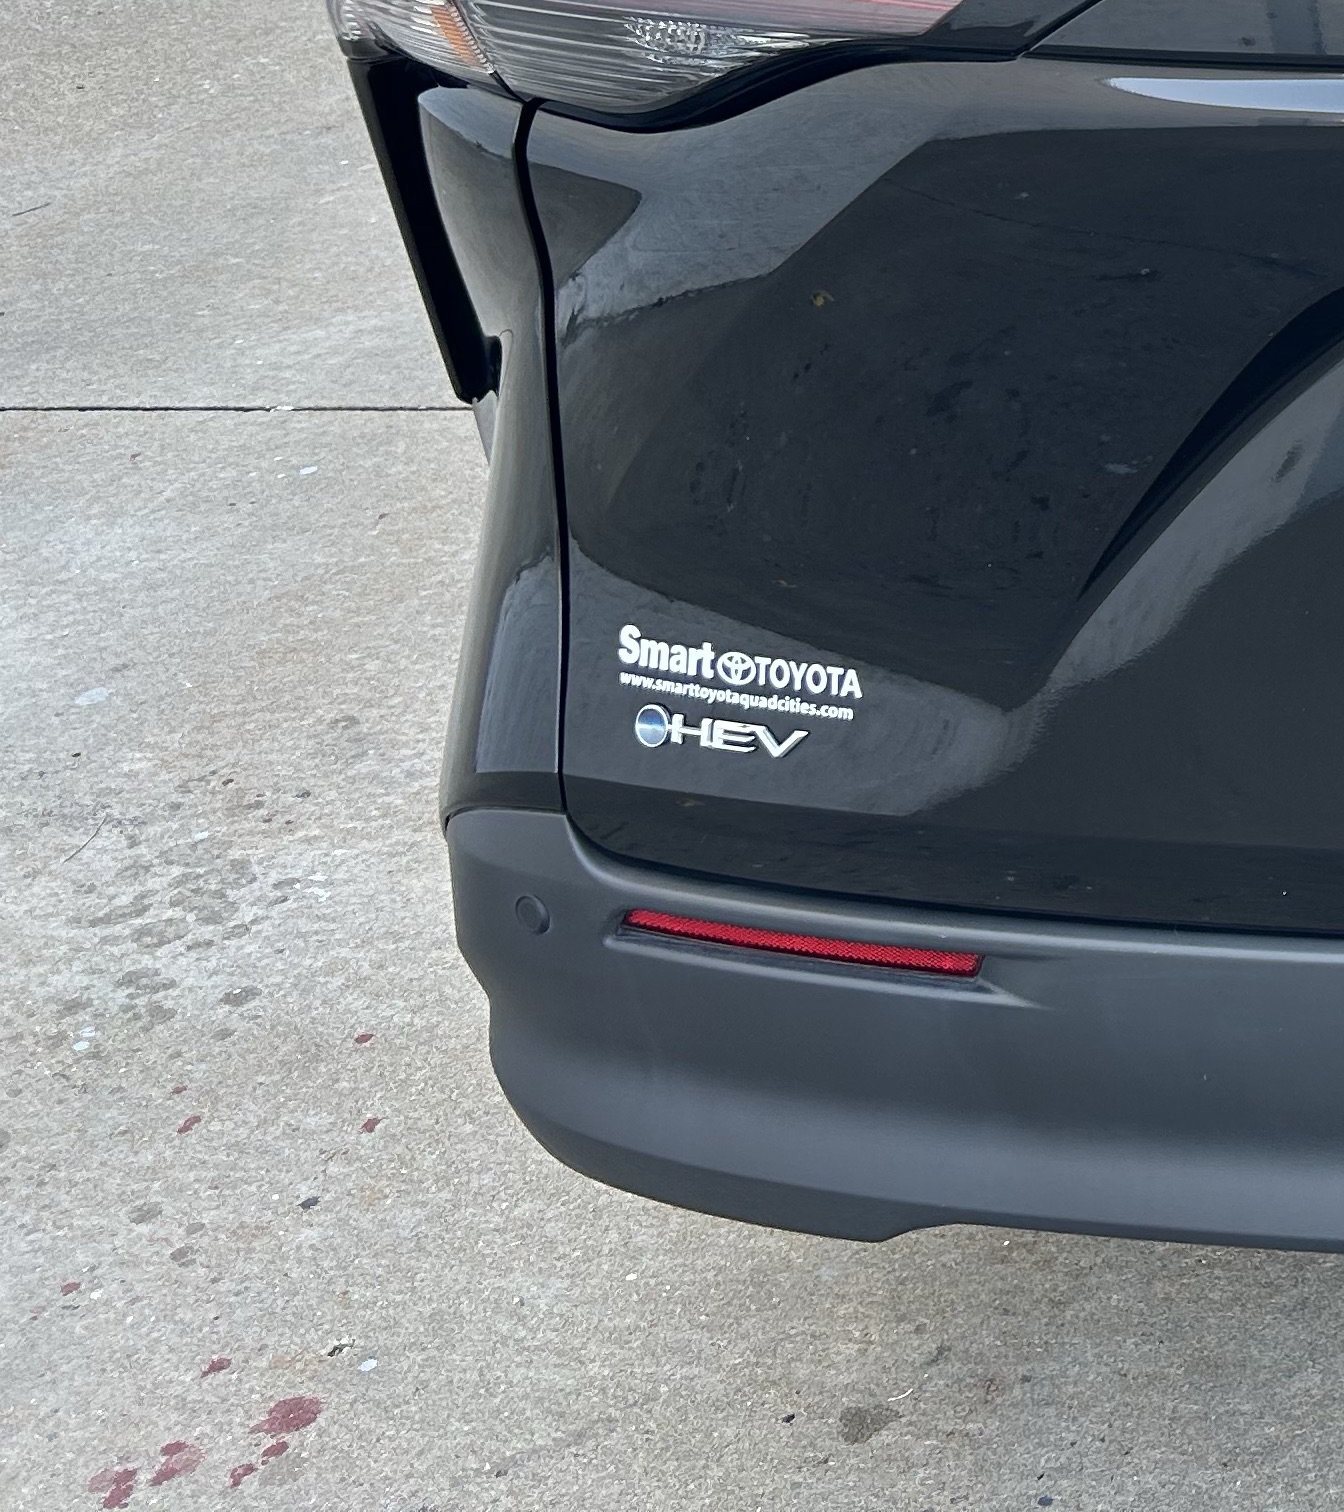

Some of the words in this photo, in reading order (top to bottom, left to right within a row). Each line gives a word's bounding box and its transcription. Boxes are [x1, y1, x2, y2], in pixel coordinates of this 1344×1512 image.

[617, 624, 715, 679] Smart
[754, 655, 864, 699] TOYOTA
[618, 670, 855, 721] www.smarttoyotaquadcities.com
[670, 713, 810, 759] HEV
